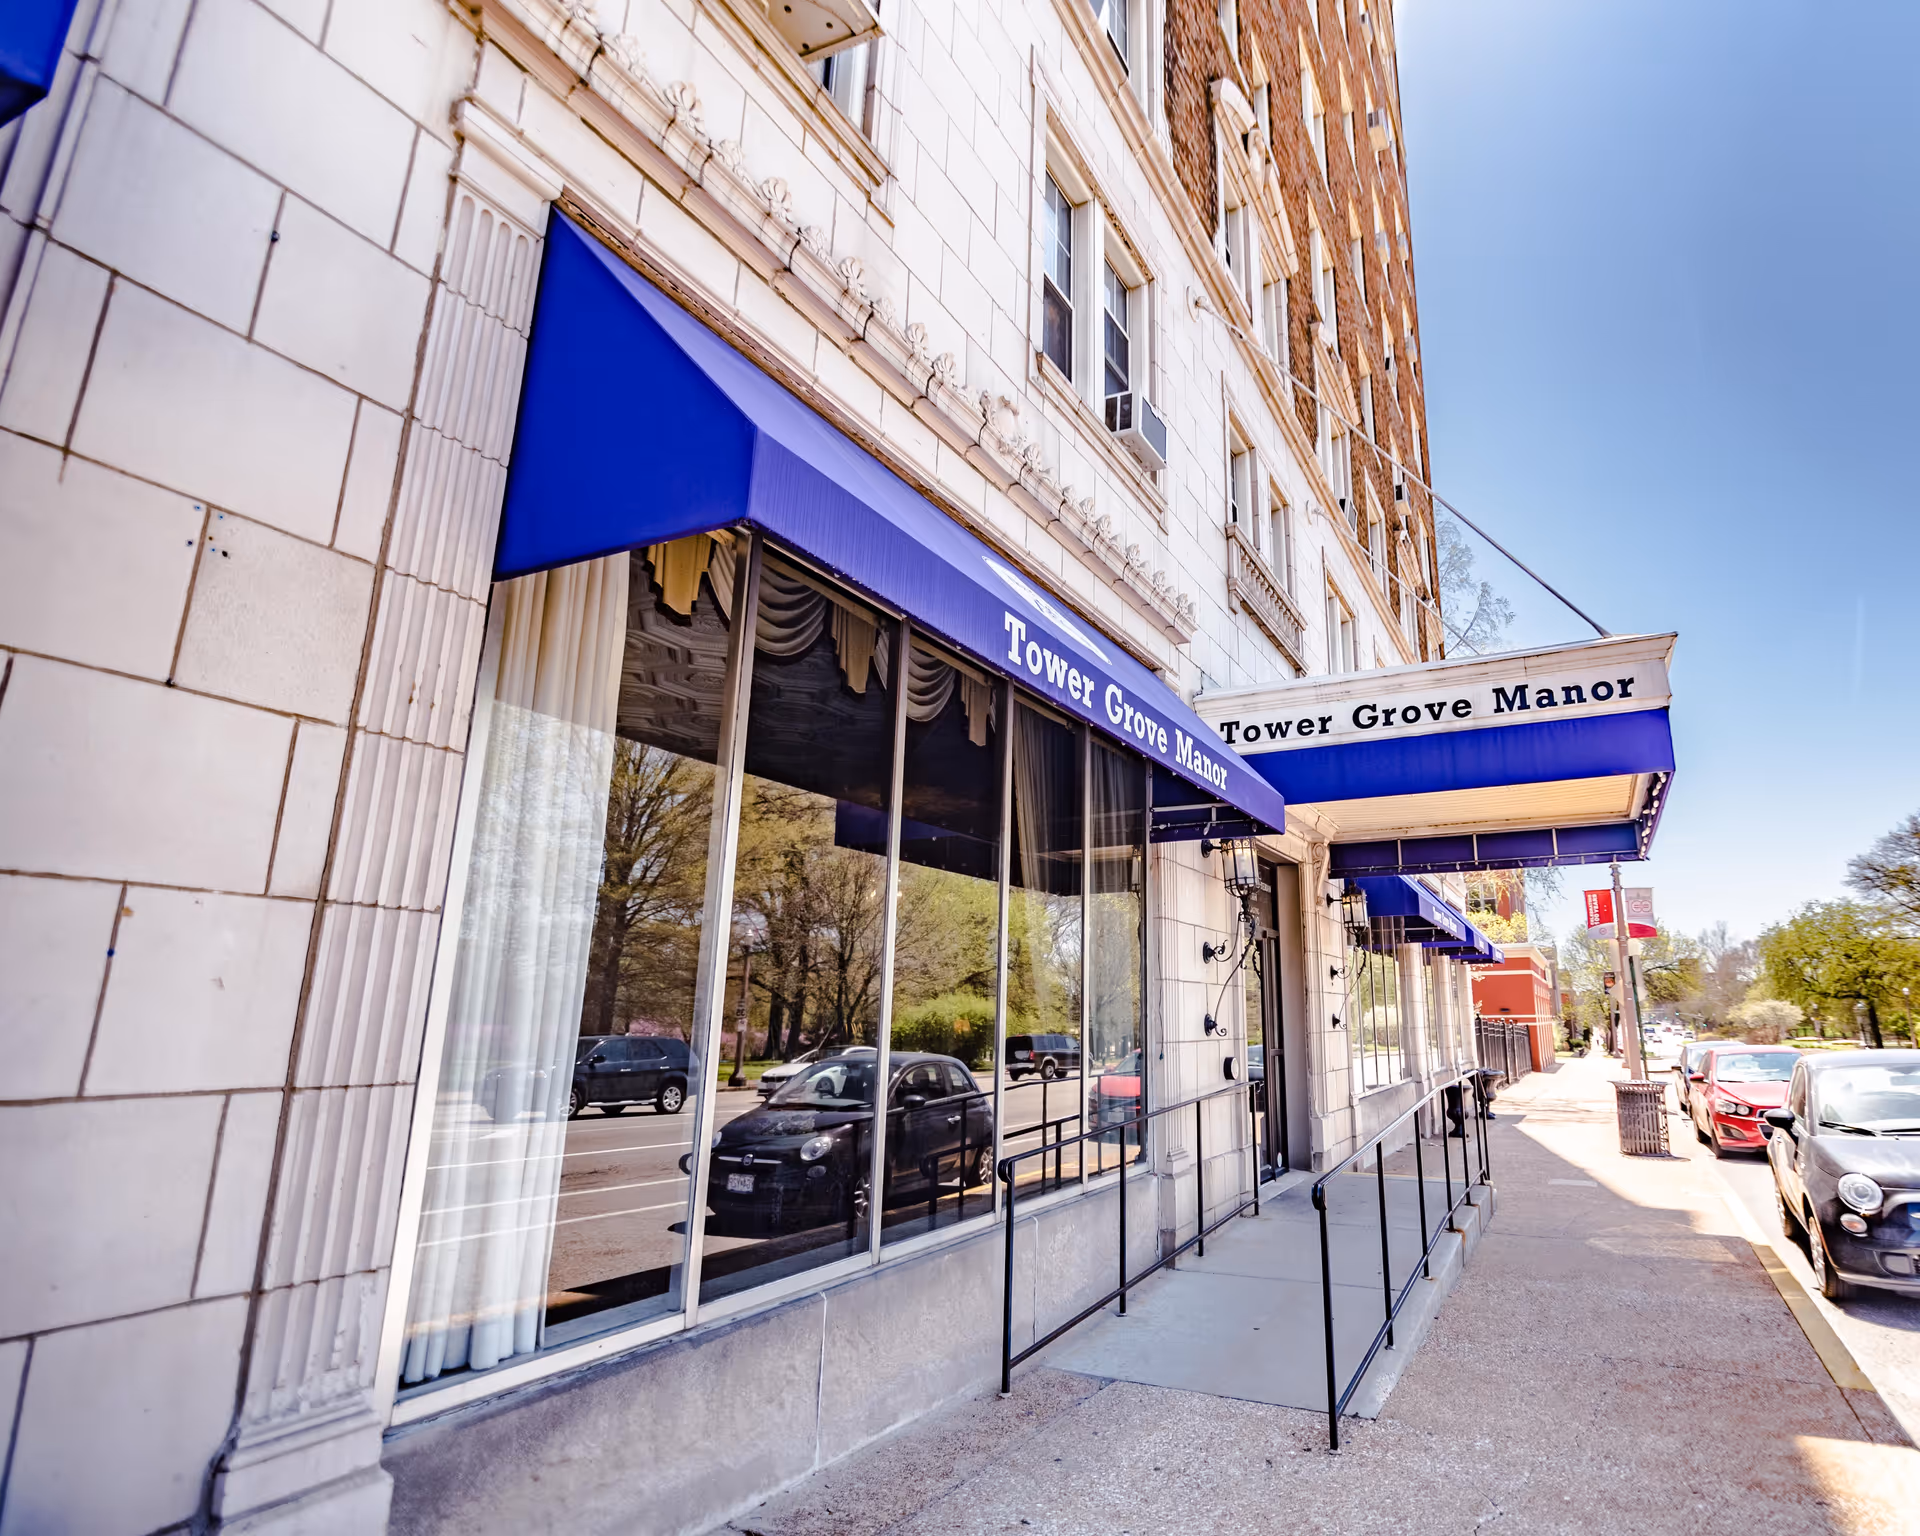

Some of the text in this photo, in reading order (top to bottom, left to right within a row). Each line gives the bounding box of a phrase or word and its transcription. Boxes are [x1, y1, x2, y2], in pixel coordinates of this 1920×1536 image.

[1004, 610, 1228, 791] Tower Grove Manor
[1219, 676, 1635, 745] Tower Grove Manor
